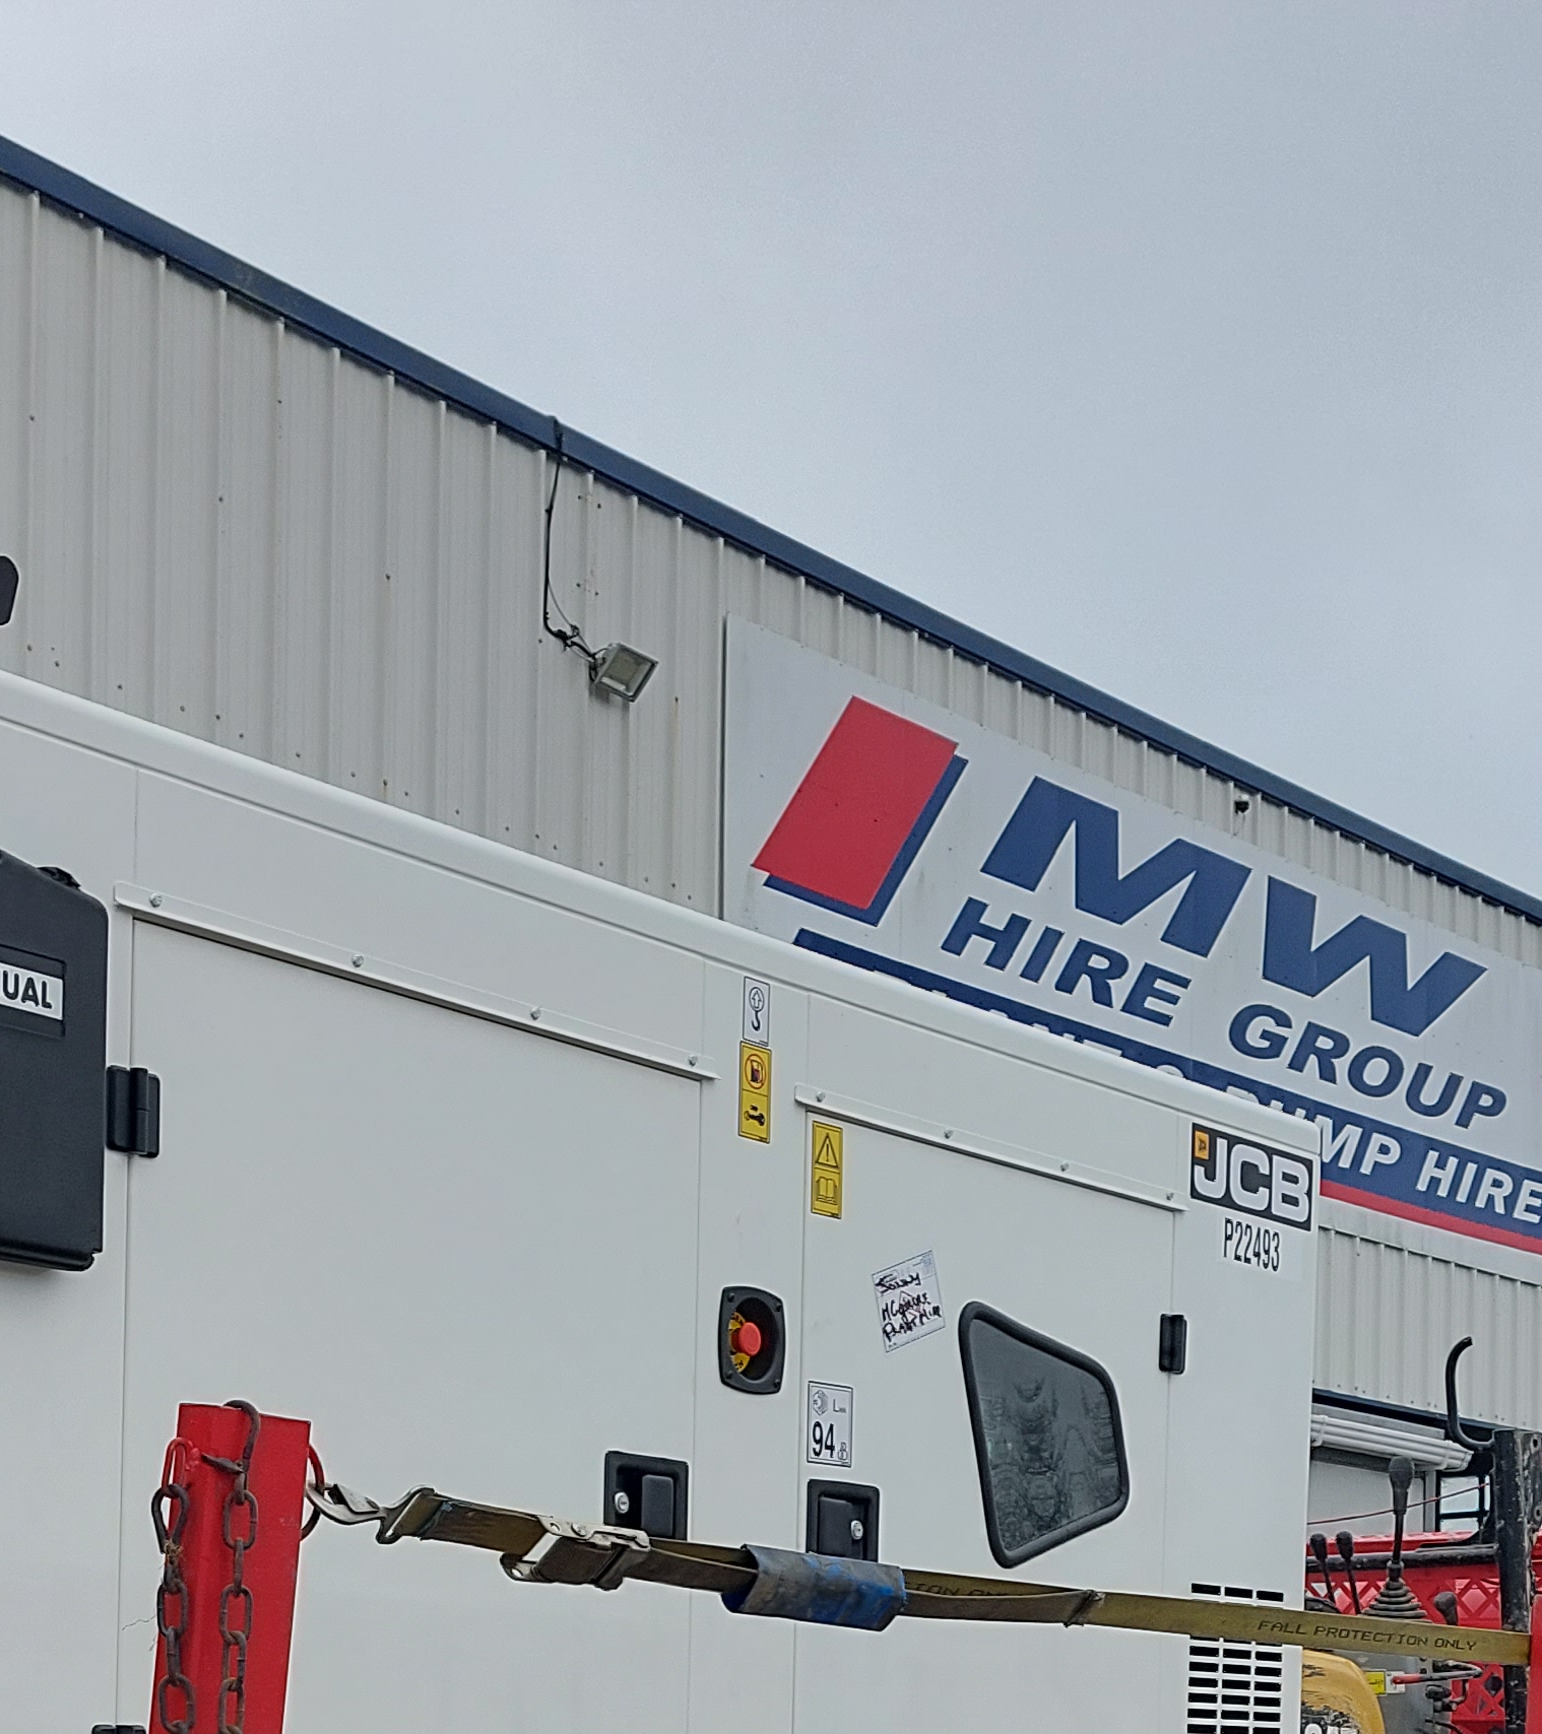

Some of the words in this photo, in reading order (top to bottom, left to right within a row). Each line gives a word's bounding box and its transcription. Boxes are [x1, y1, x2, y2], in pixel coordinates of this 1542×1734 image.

[980, 776, 1488, 1037] MW
[940, 896, 1192, 1027] HIRE
[1228, 1003, 1508, 1129] GROUP
[1194, 1136, 1310, 1223] JCB
[1223, 1217, 1280, 1272] P22493
[812, 1421, 835, 1458] 94
[1258, 1621, 1306, 1635] FALL
[1314, 1626, 1428, 1646] PROTECTION
[1434, 1637, 1477, 1651] ONLY
